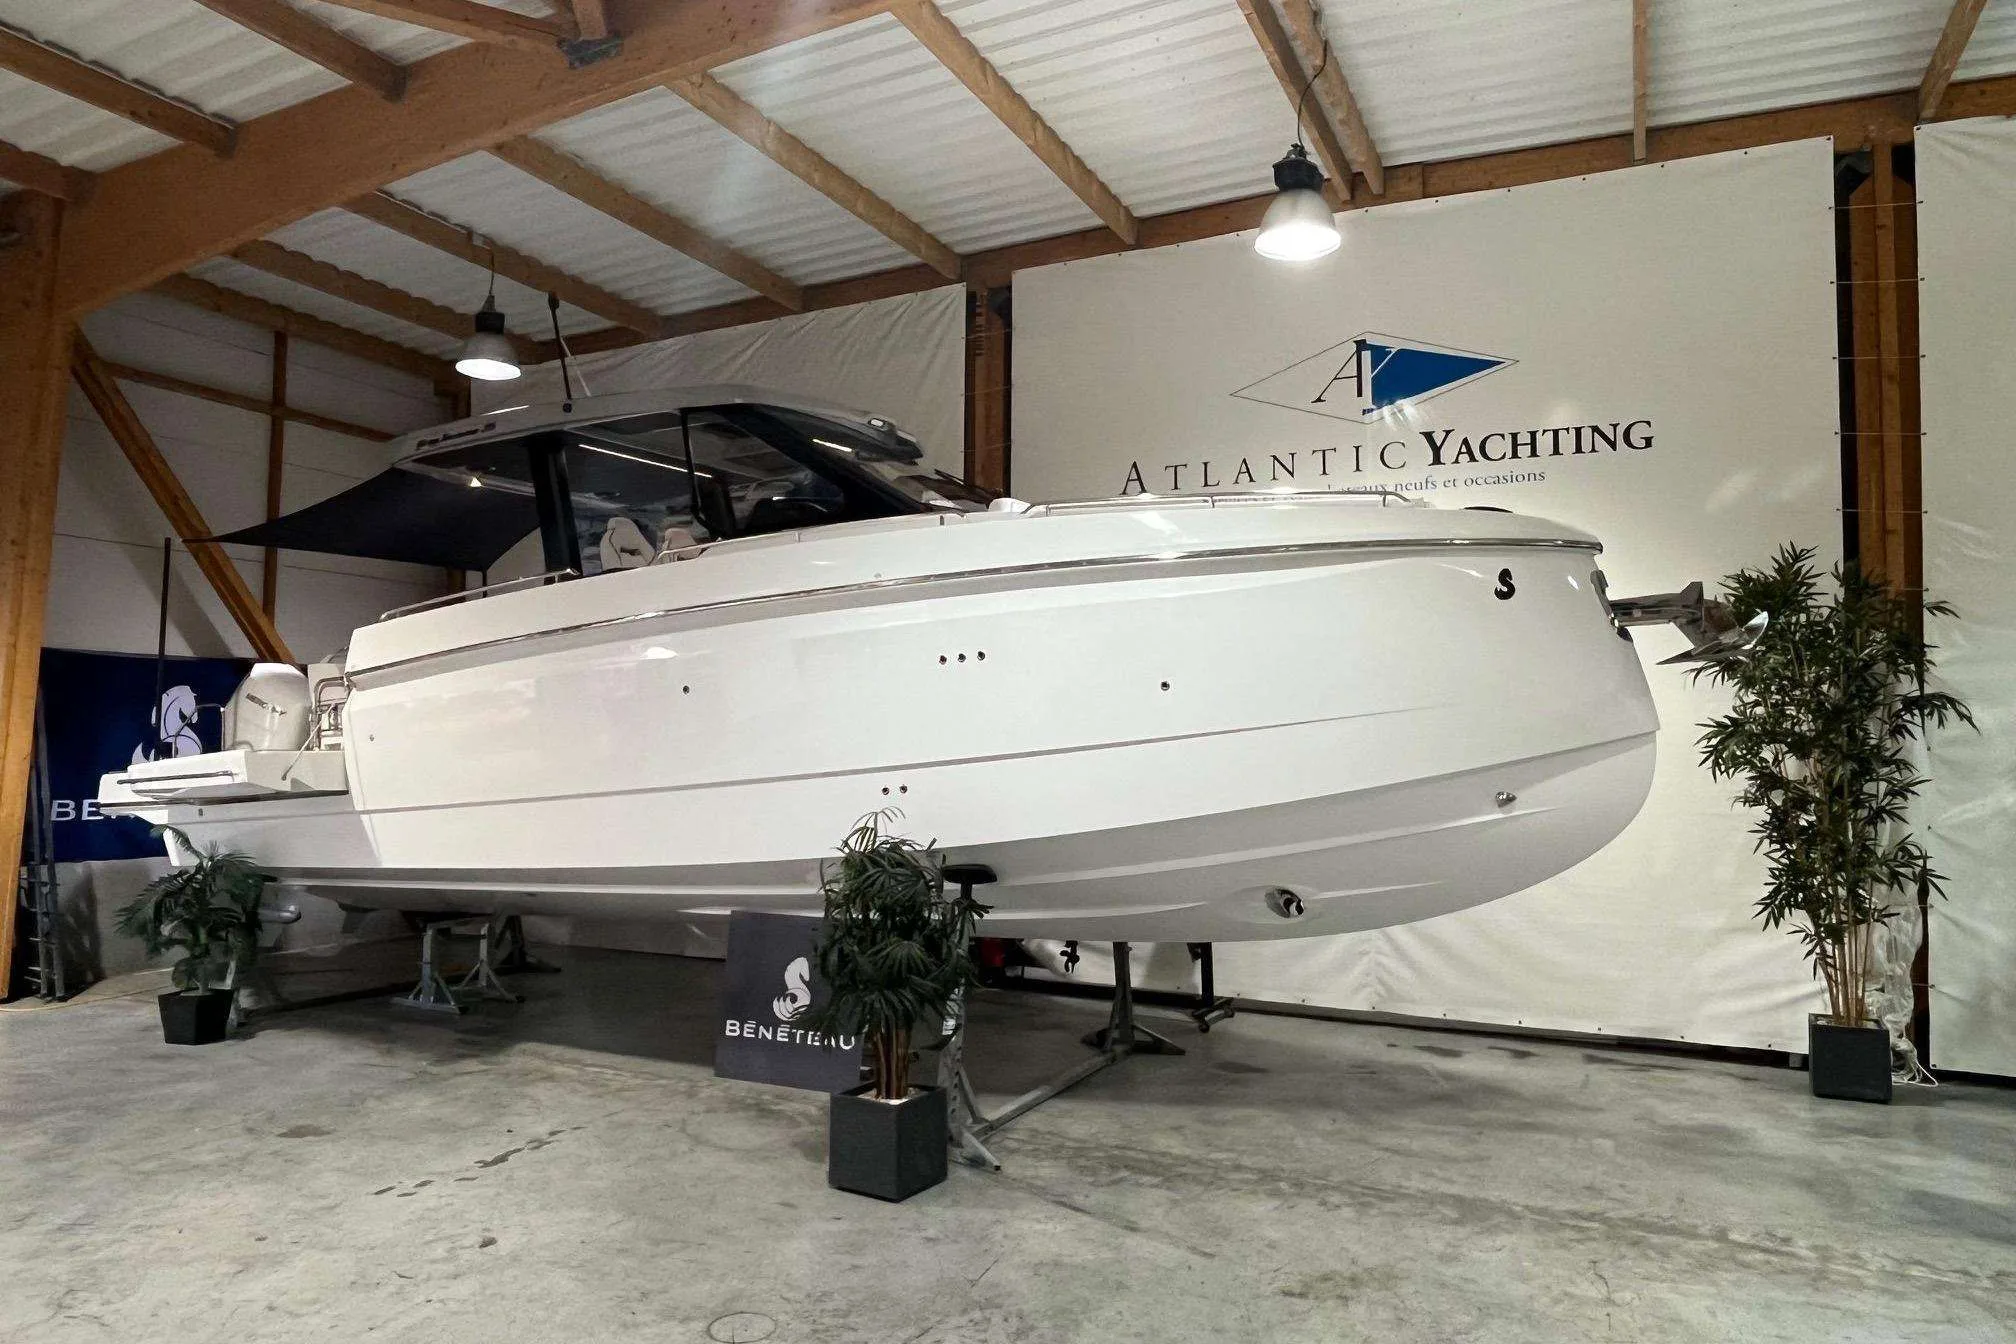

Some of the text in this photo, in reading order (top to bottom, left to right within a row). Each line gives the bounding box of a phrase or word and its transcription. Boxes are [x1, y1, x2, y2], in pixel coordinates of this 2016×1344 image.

[1119, 420, 1654, 496] ATLANTIC YACHTING
[1393, 475, 1438, 492] neufs
[1443, 477, 1457, 488] et
[1464, 470, 1546, 487] occasions
